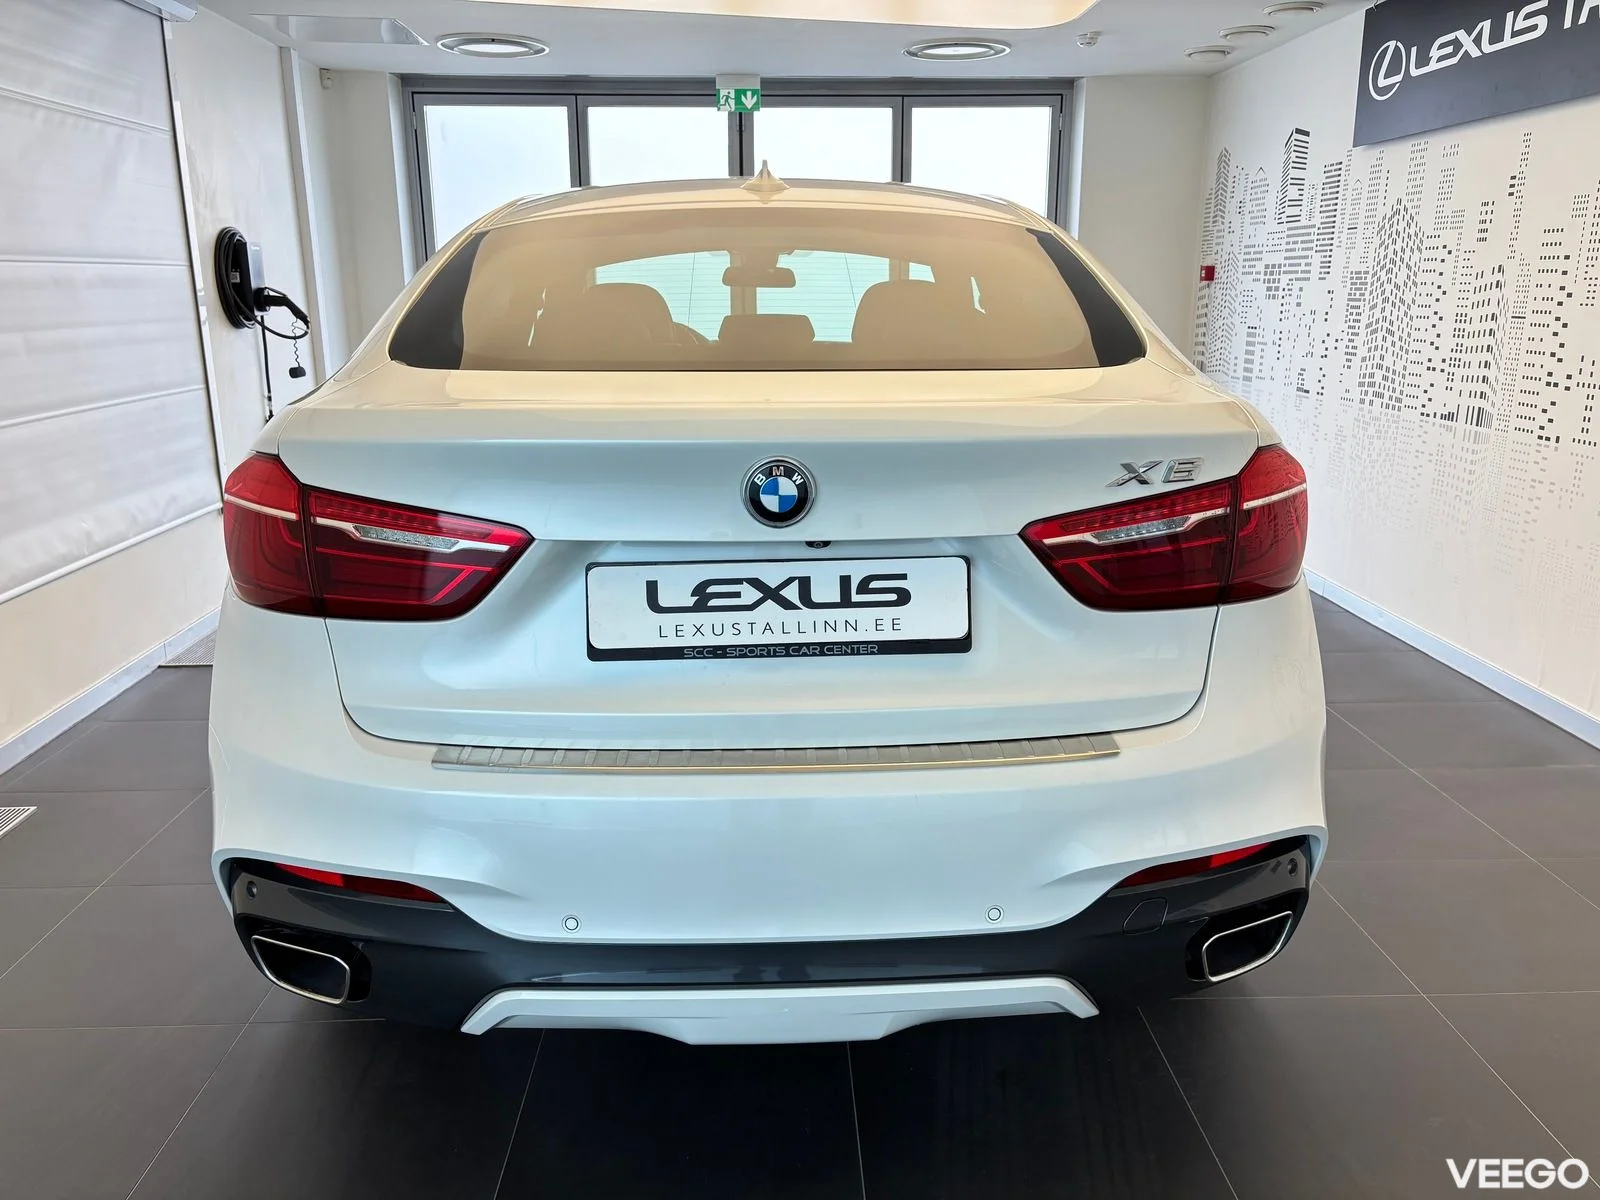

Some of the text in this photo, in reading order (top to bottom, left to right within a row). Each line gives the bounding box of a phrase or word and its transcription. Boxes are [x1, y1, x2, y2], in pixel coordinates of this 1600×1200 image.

[1410, 0, 1548, 77] LEXUS
[753, 466, 804, 486] BMW
[1105, 457, 1204, 488] X6
[645, 573, 912, 614] LEXUS
[659, 617, 902, 638] LEXUSTALLINN.EE
[683, 648, 714, 658] SCC
[726, 646, 785, 657] SPORTS
[789, 645, 820, 655] CAR
[824, 644, 879, 655] CENTER
